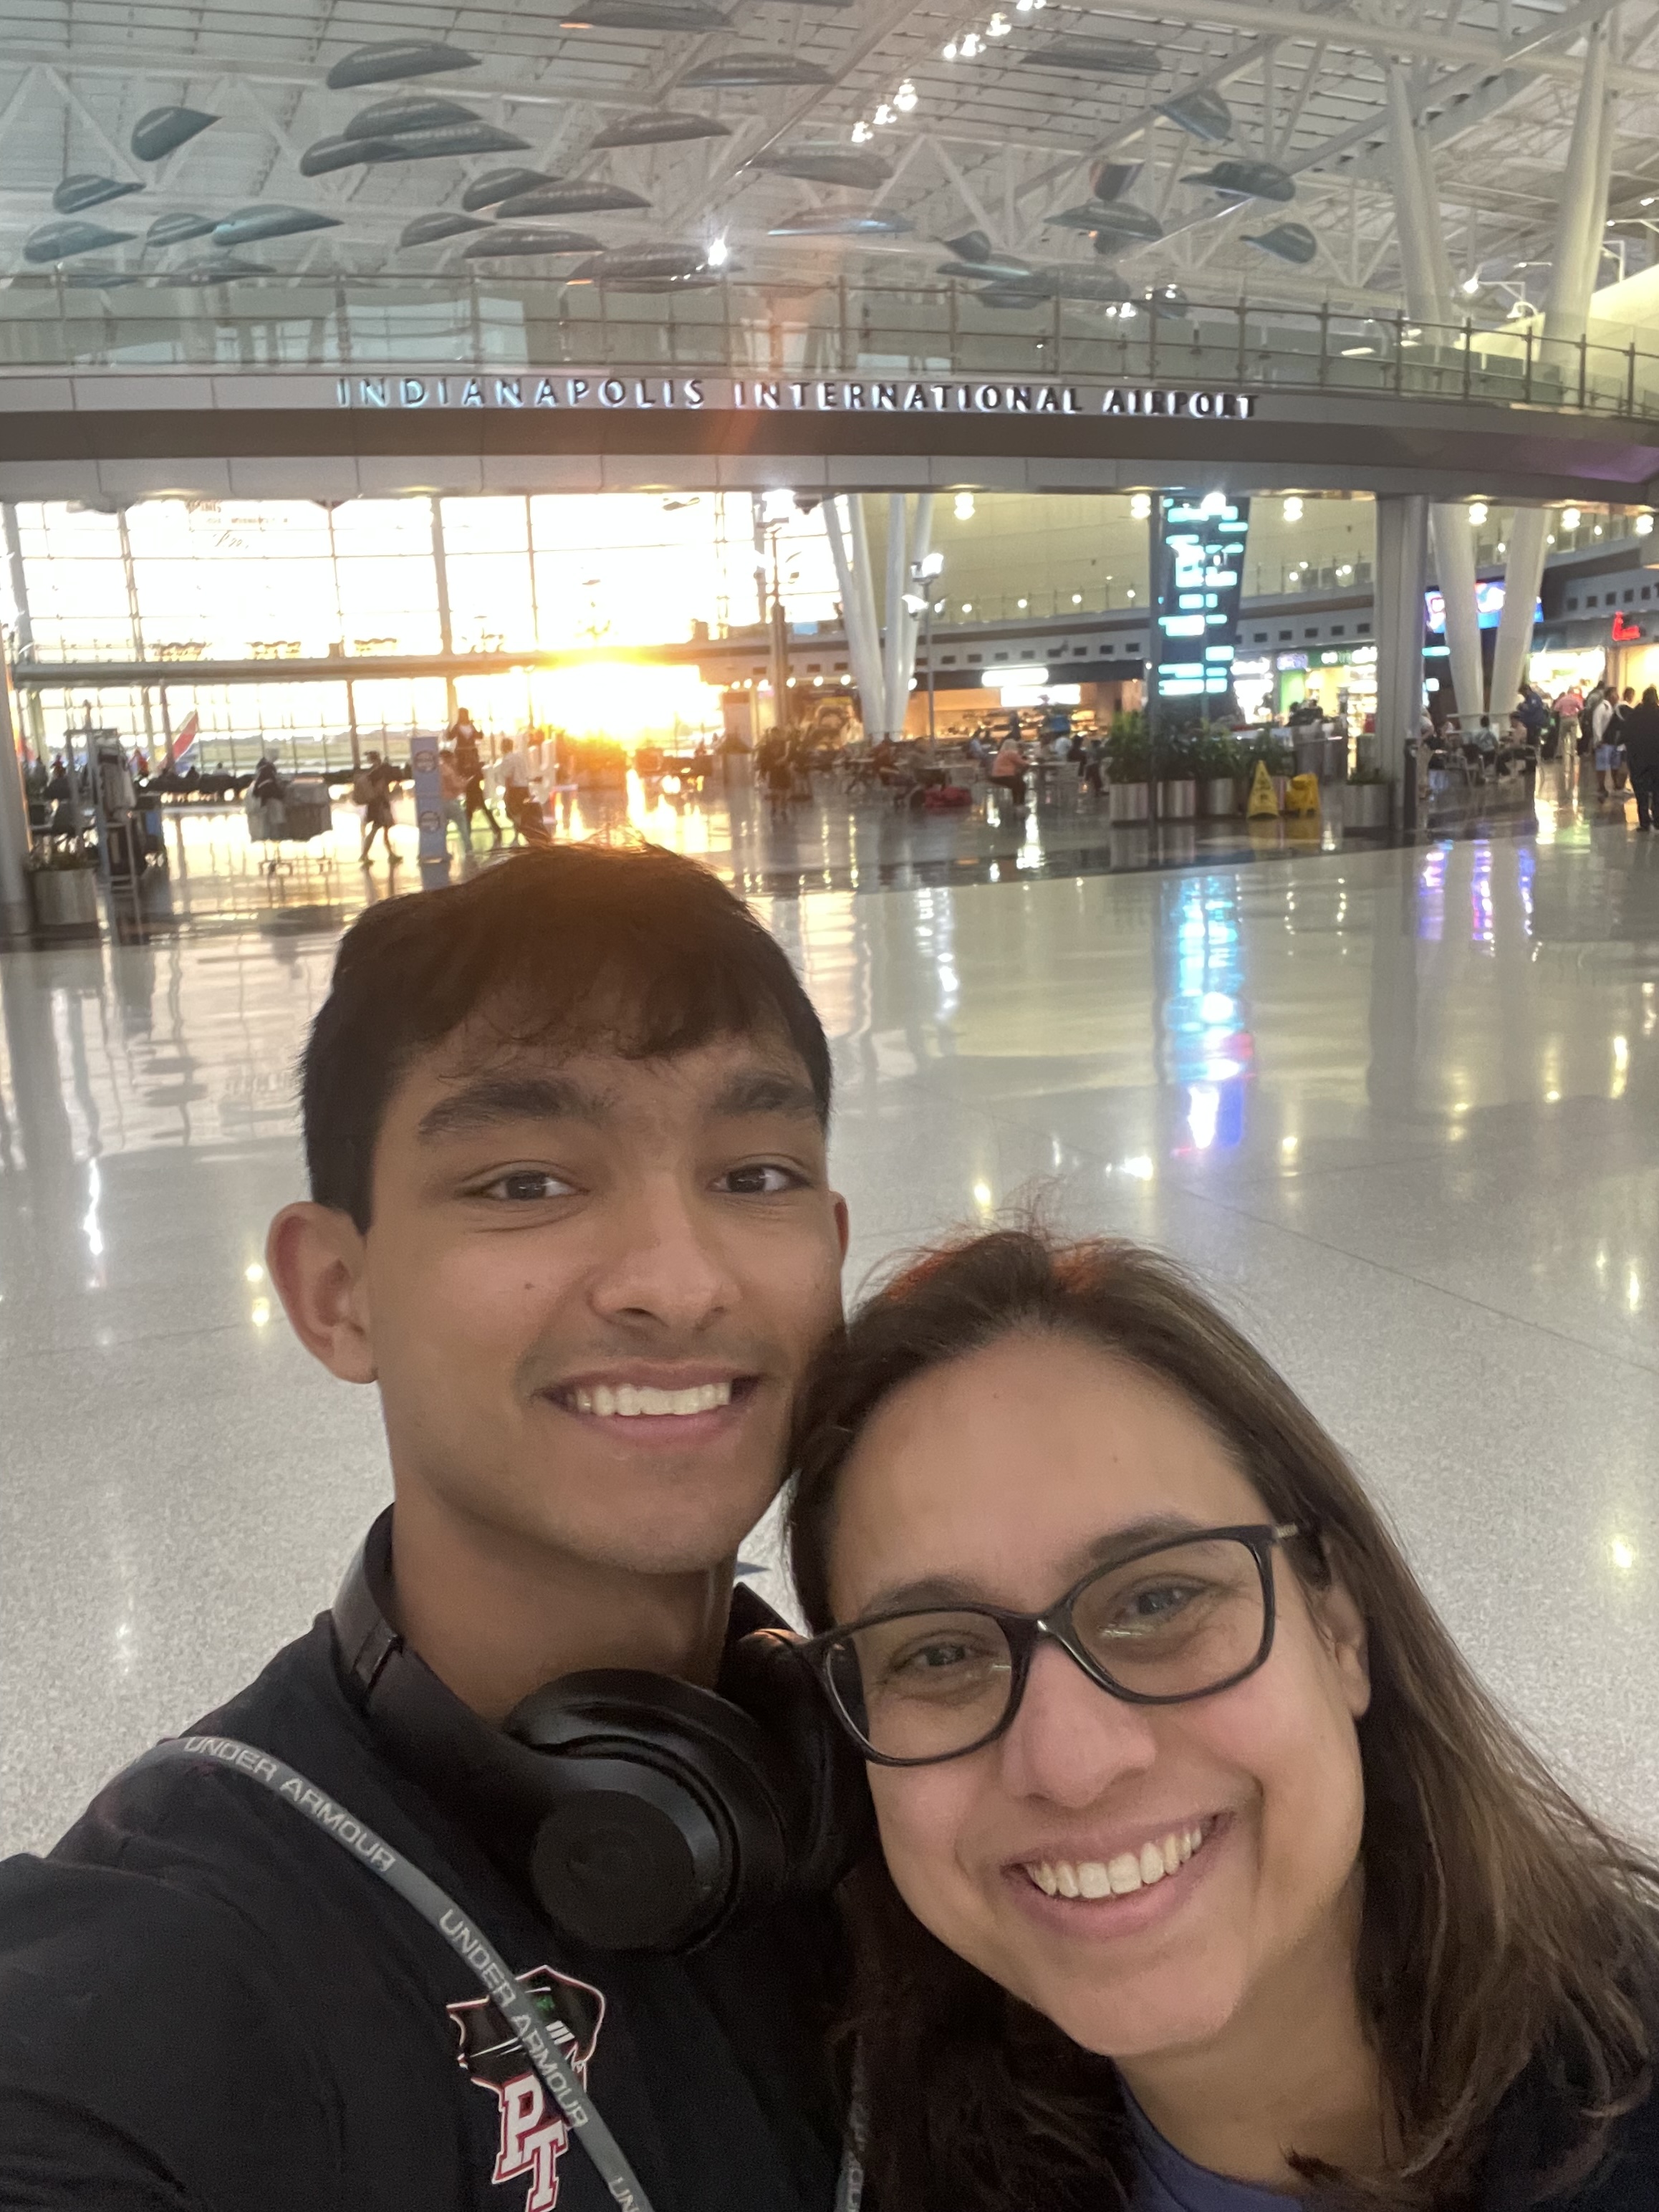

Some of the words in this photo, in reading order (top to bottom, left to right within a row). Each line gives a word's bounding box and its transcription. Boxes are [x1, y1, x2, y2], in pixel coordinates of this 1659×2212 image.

[335, 377, 704, 410] INDIANAPOLIS
[732, 380, 1083, 415] INTERNATIONAL
[1102, 388, 1259, 419] AIRPORT
[183, 1736, 277, 1782] UNDER
[279, 1778, 395, 1872] ARMOUR
[438, 1909, 516, 2006] UNDER
[511, 2014, 589, 2127] ARMOUR
